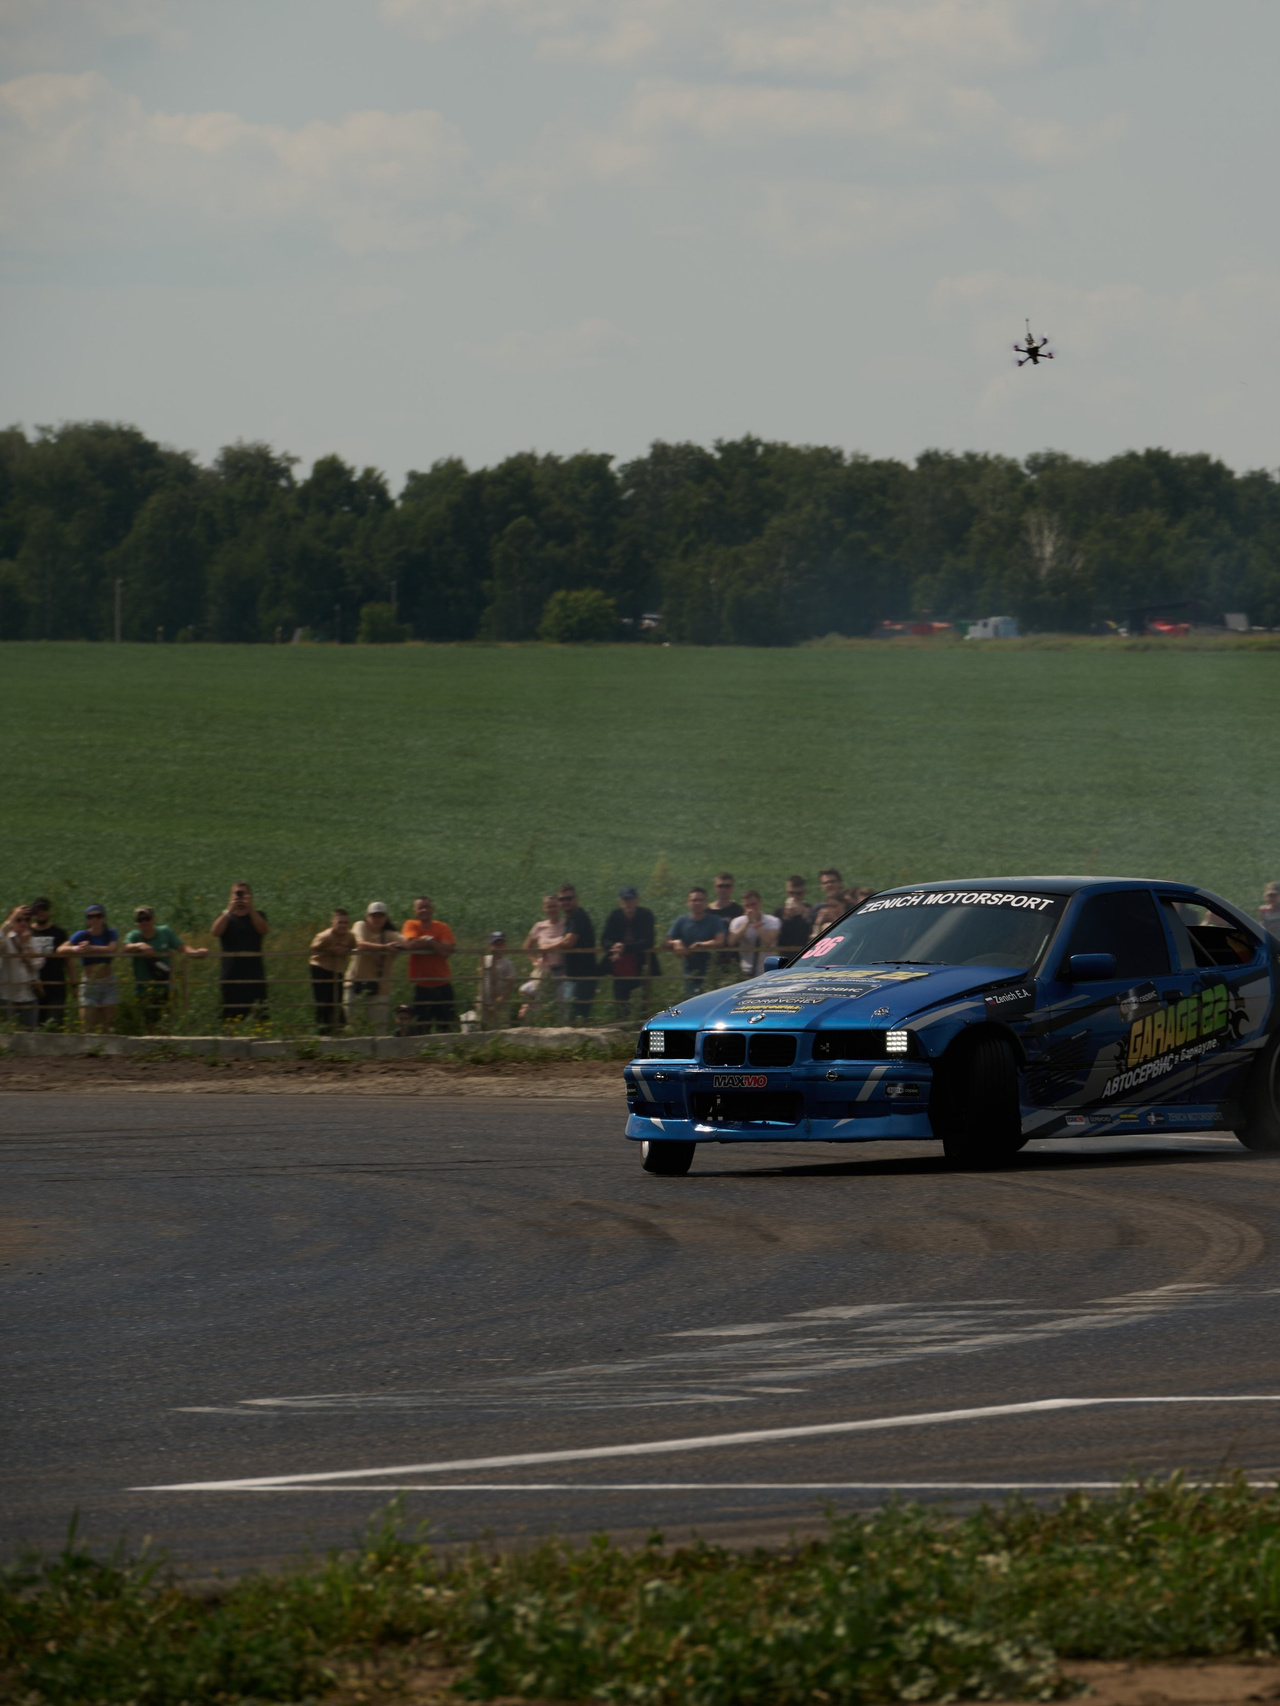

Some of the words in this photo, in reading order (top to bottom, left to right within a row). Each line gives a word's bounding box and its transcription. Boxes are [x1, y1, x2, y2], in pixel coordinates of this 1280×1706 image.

[857, 893, 926, 915] ZENICH
[922, 892, 1054, 911] MOTORSPORT
[801, 936, 845, 959] 36
[993, 991, 1018, 1003] Zenich
[1015, 988, 1031, 998] E.A.
[1126, 994, 1199, 1068] GARAGE
[1200, 983, 1229, 1036] 22
[713, 1075, 767, 1088] MAXMO
[1101, 1053, 1175, 1099] АВТОСЕРВИС
